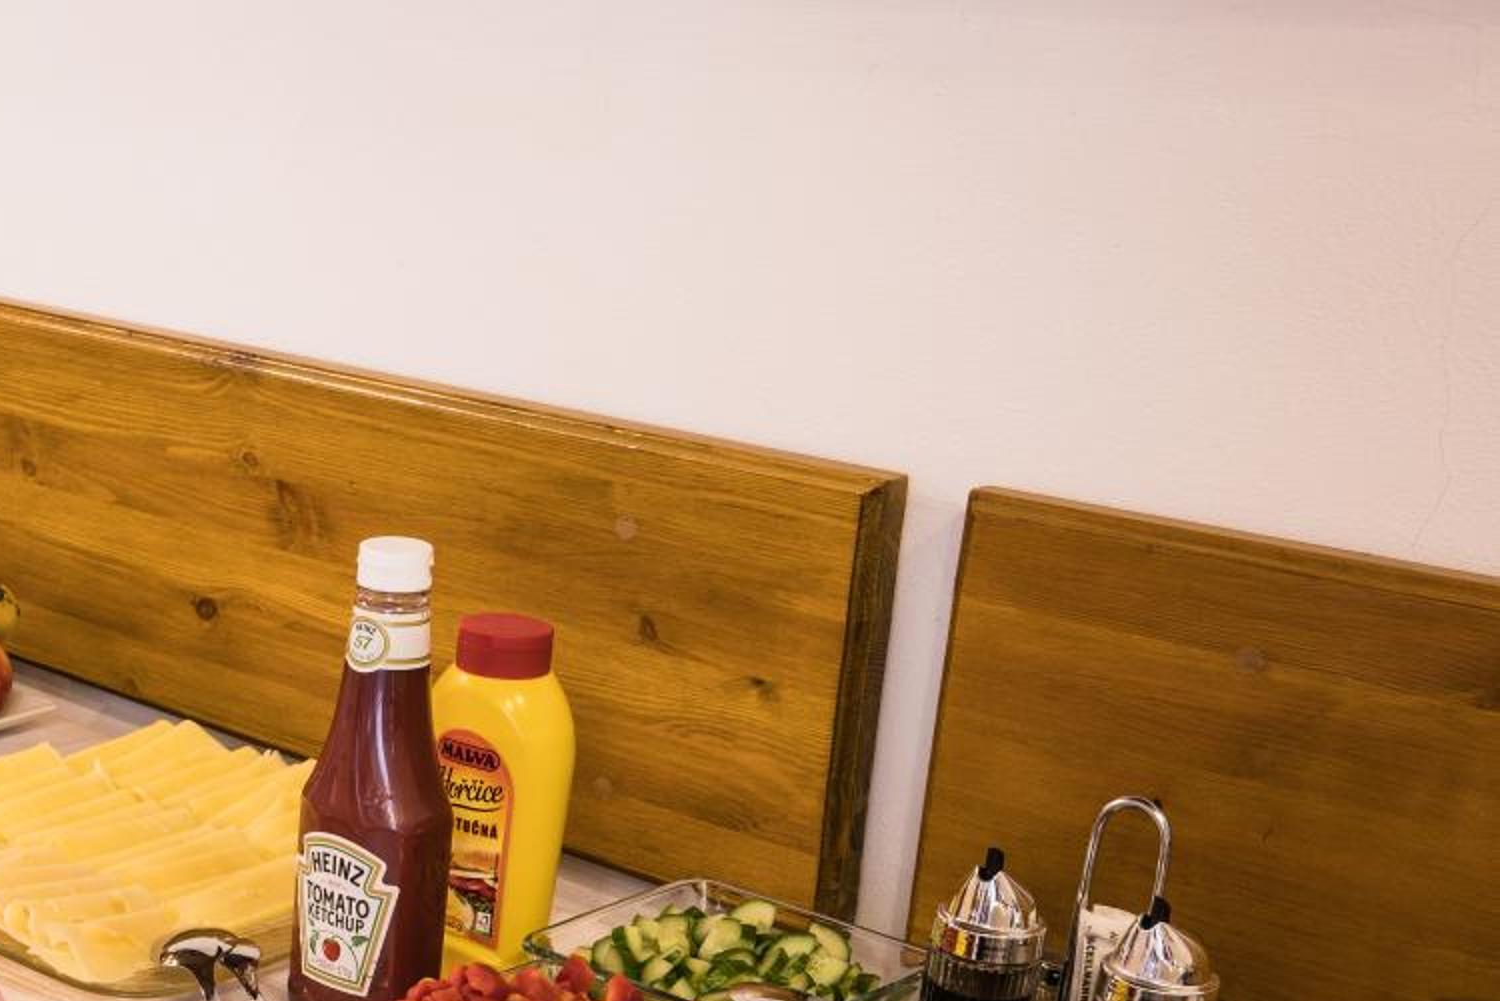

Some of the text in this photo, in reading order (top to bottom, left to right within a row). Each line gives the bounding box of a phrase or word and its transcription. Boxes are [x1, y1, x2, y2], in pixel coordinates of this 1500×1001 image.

[441, 740, 498, 769] MALVA
[311, 851, 365, 887] HEINZ
[307, 879, 369, 919] TOMATO
[308, 903, 365, 933] KETCHUP
